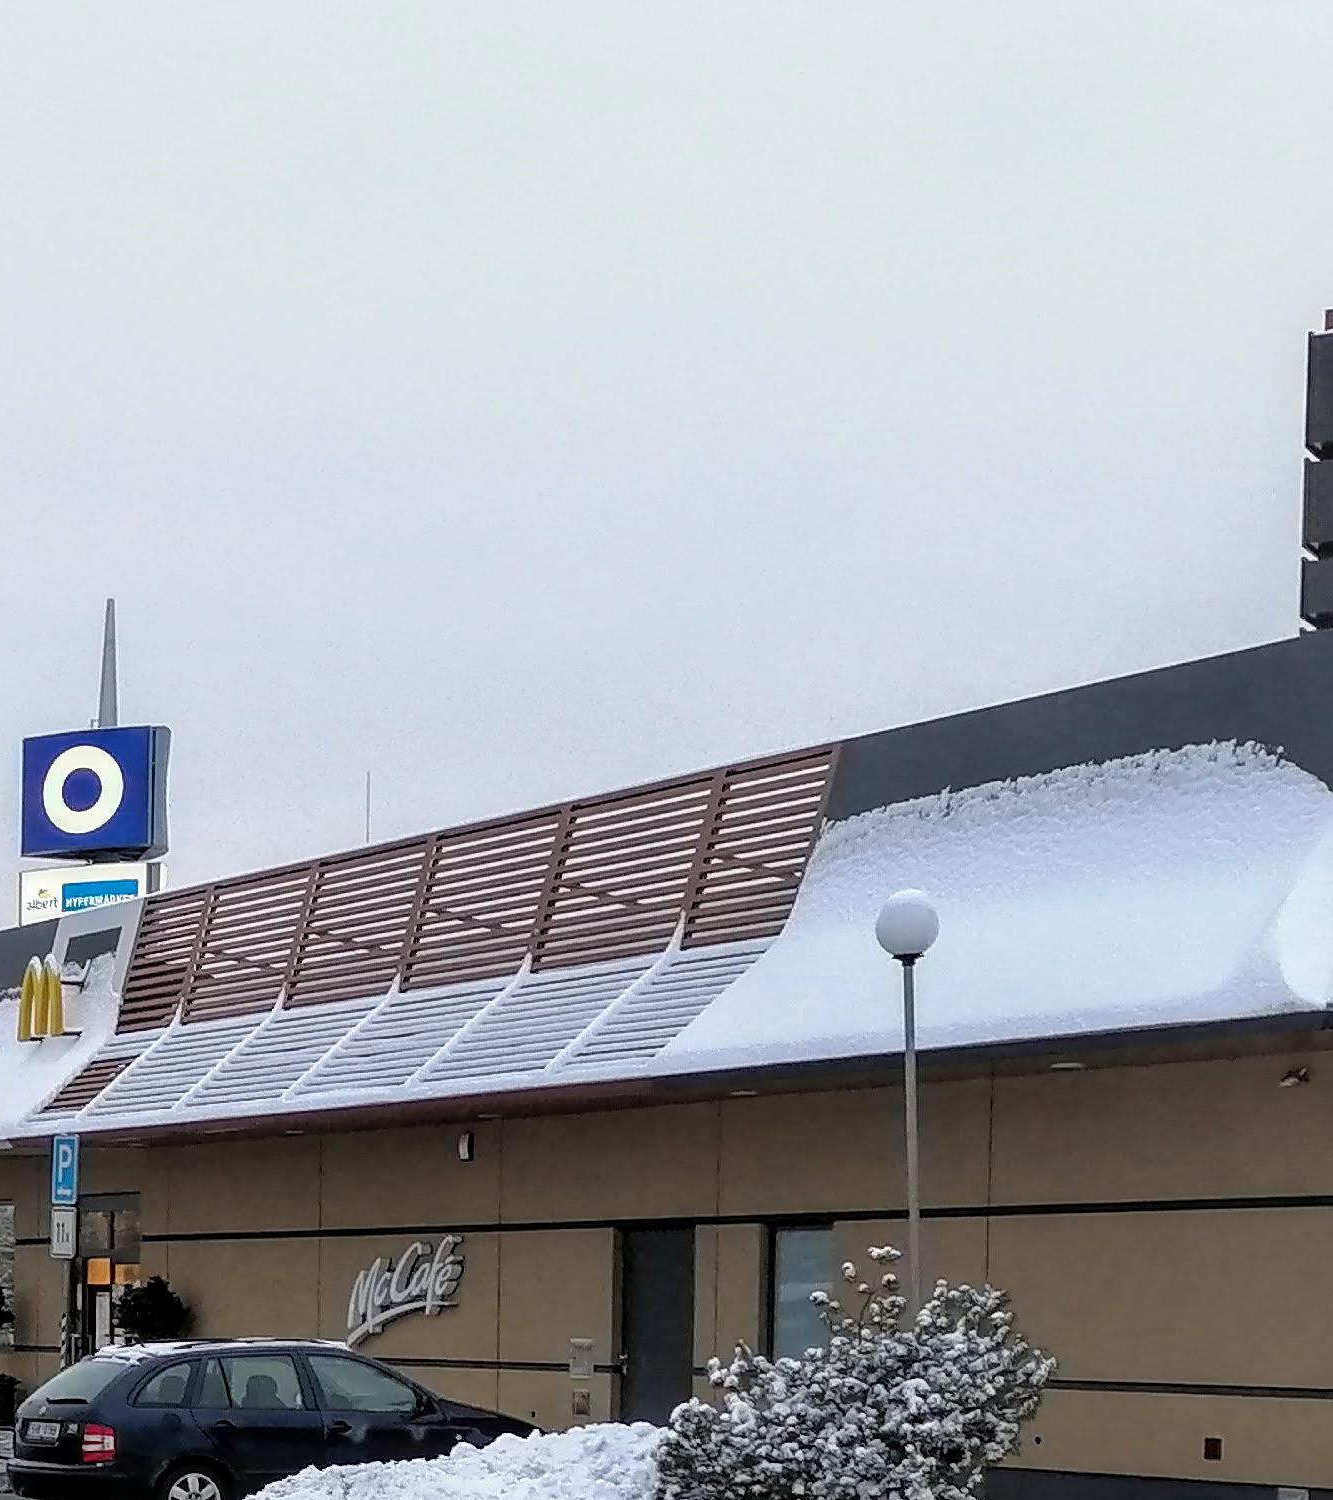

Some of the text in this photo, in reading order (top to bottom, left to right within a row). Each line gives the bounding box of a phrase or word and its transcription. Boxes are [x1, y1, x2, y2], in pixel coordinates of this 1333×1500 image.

[26, 897, 59, 911] albert
[58, 1144, 73, 1183] P
[347, 1235, 465, 1334] McCafé
